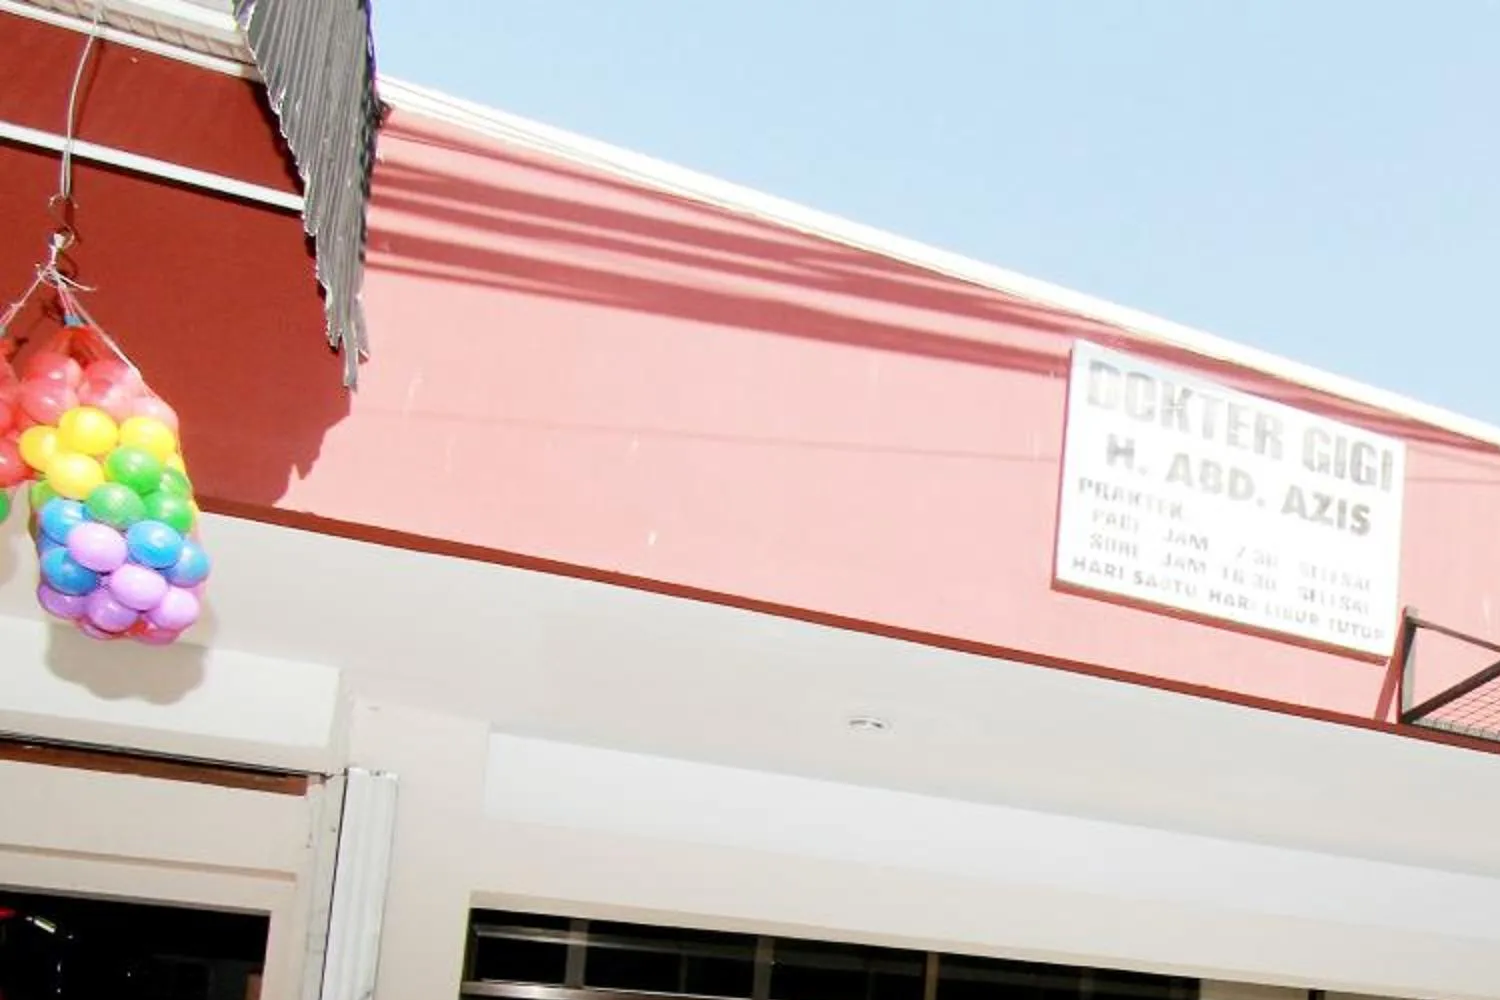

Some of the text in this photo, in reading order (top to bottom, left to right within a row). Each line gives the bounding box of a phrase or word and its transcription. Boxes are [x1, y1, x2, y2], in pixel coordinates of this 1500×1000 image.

[1086, 359, 1394, 493] DOKTER GIGI
[1106, 433, 1372, 537] H. ABD. AZIS
[1162, 528, 1209, 552] JAM
[1071, 555, 1124, 581] HARI
[1161, 551, 1207, 576] JAM
